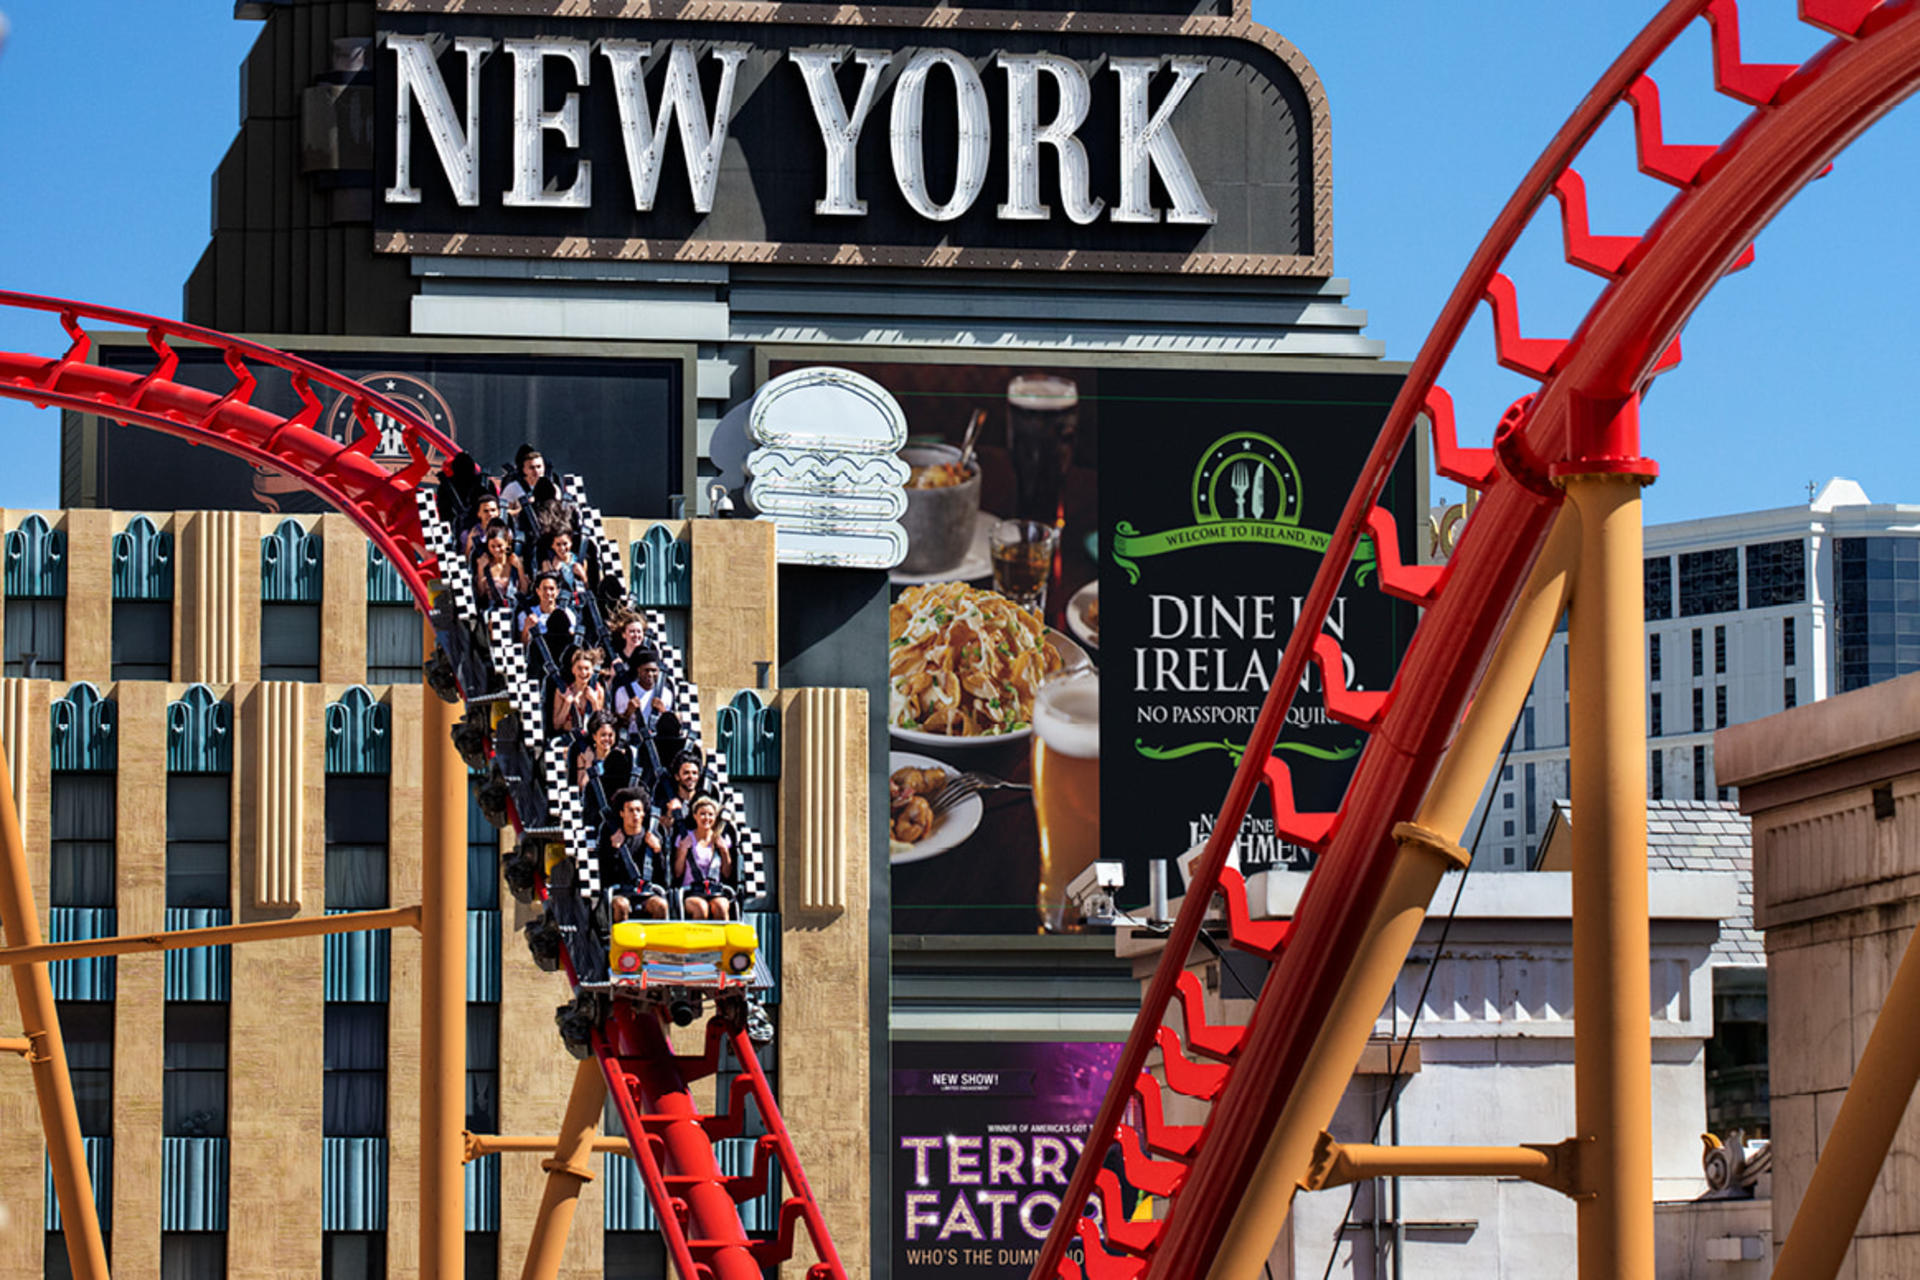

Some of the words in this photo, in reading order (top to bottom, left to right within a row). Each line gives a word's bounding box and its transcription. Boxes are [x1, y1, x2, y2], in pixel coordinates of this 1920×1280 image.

[384, 33, 748, 214] NEW
[787, 46, 1218, 226] YORK
[1166, 526, 1227, 546] WELCOME
[1230, 525, 1248, 538] TO
[1309, 535, 1329, 548] NV
[1149, 594, 1276, 640] DINE
[1136, 706, 1168, 724] NO
[1172, 706, 1260, 724] PASSPORT
[932, 1073, 959, 1085] NEW
[960, 1073, 999, 1086] SHOW!
[987, 1124, 1017, 1133] WINNER
[1019, 1124, 1029, 1133] OF
[906, 1248, 958, 1265] WHO'S
[964, 1248, 993, 1265] THE
[999, 1248, 1042, 1265] DUM
